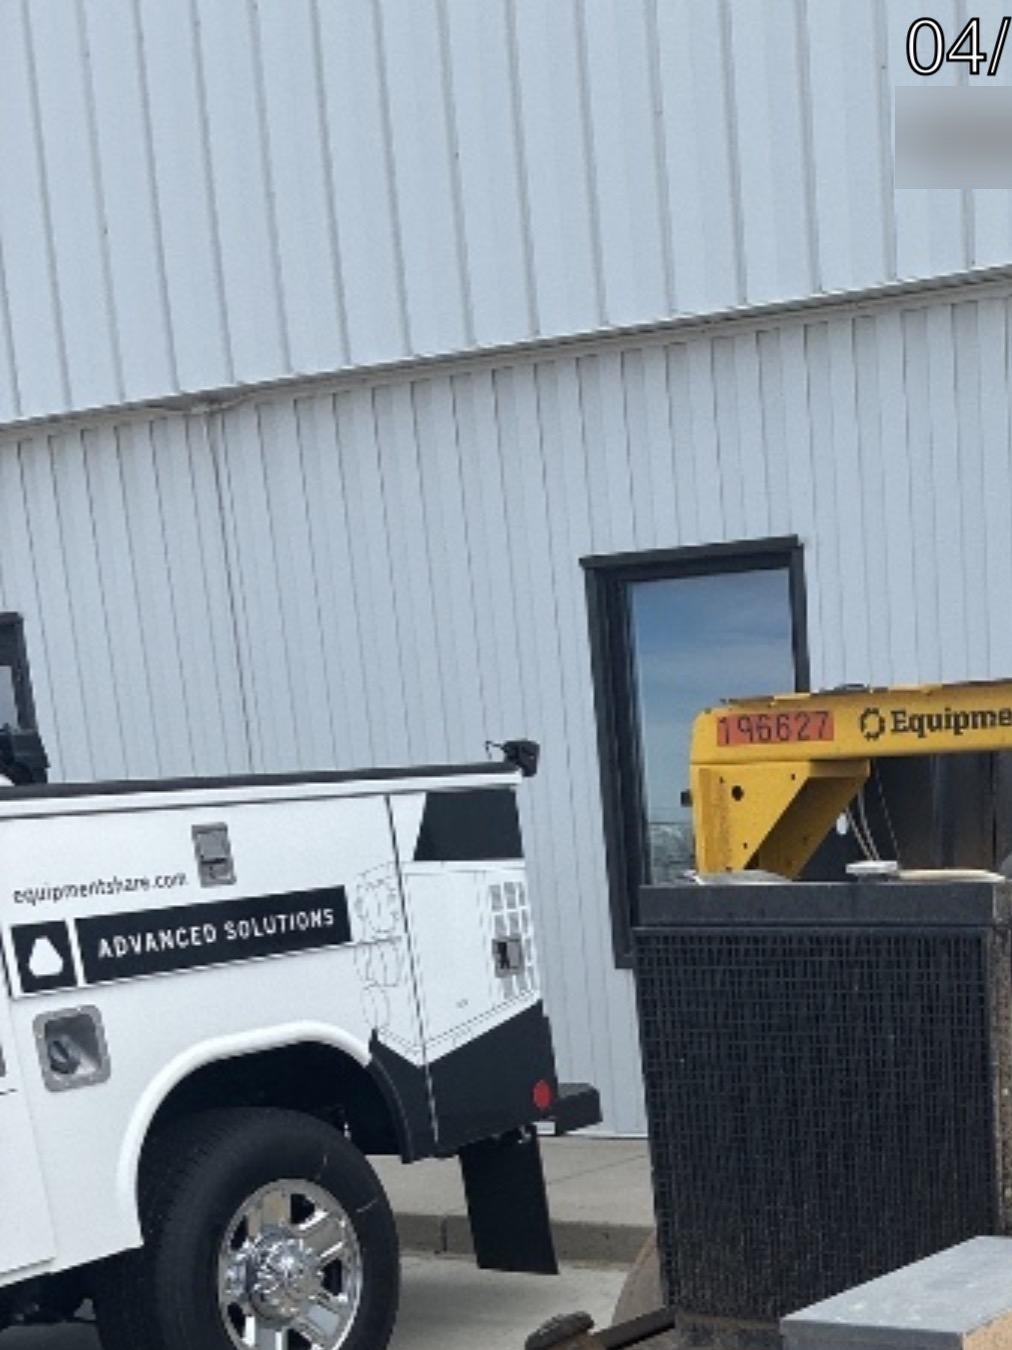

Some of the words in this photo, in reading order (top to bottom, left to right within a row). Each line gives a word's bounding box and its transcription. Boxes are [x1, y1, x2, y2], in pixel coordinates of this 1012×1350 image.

[719, 710, 829, 745] 196627
[13, 872, 188, 907] equipmentshare.com
[97, 923, 217, 959] ADVANCED
[223, 907, 336, 941] SOLUTIONS
